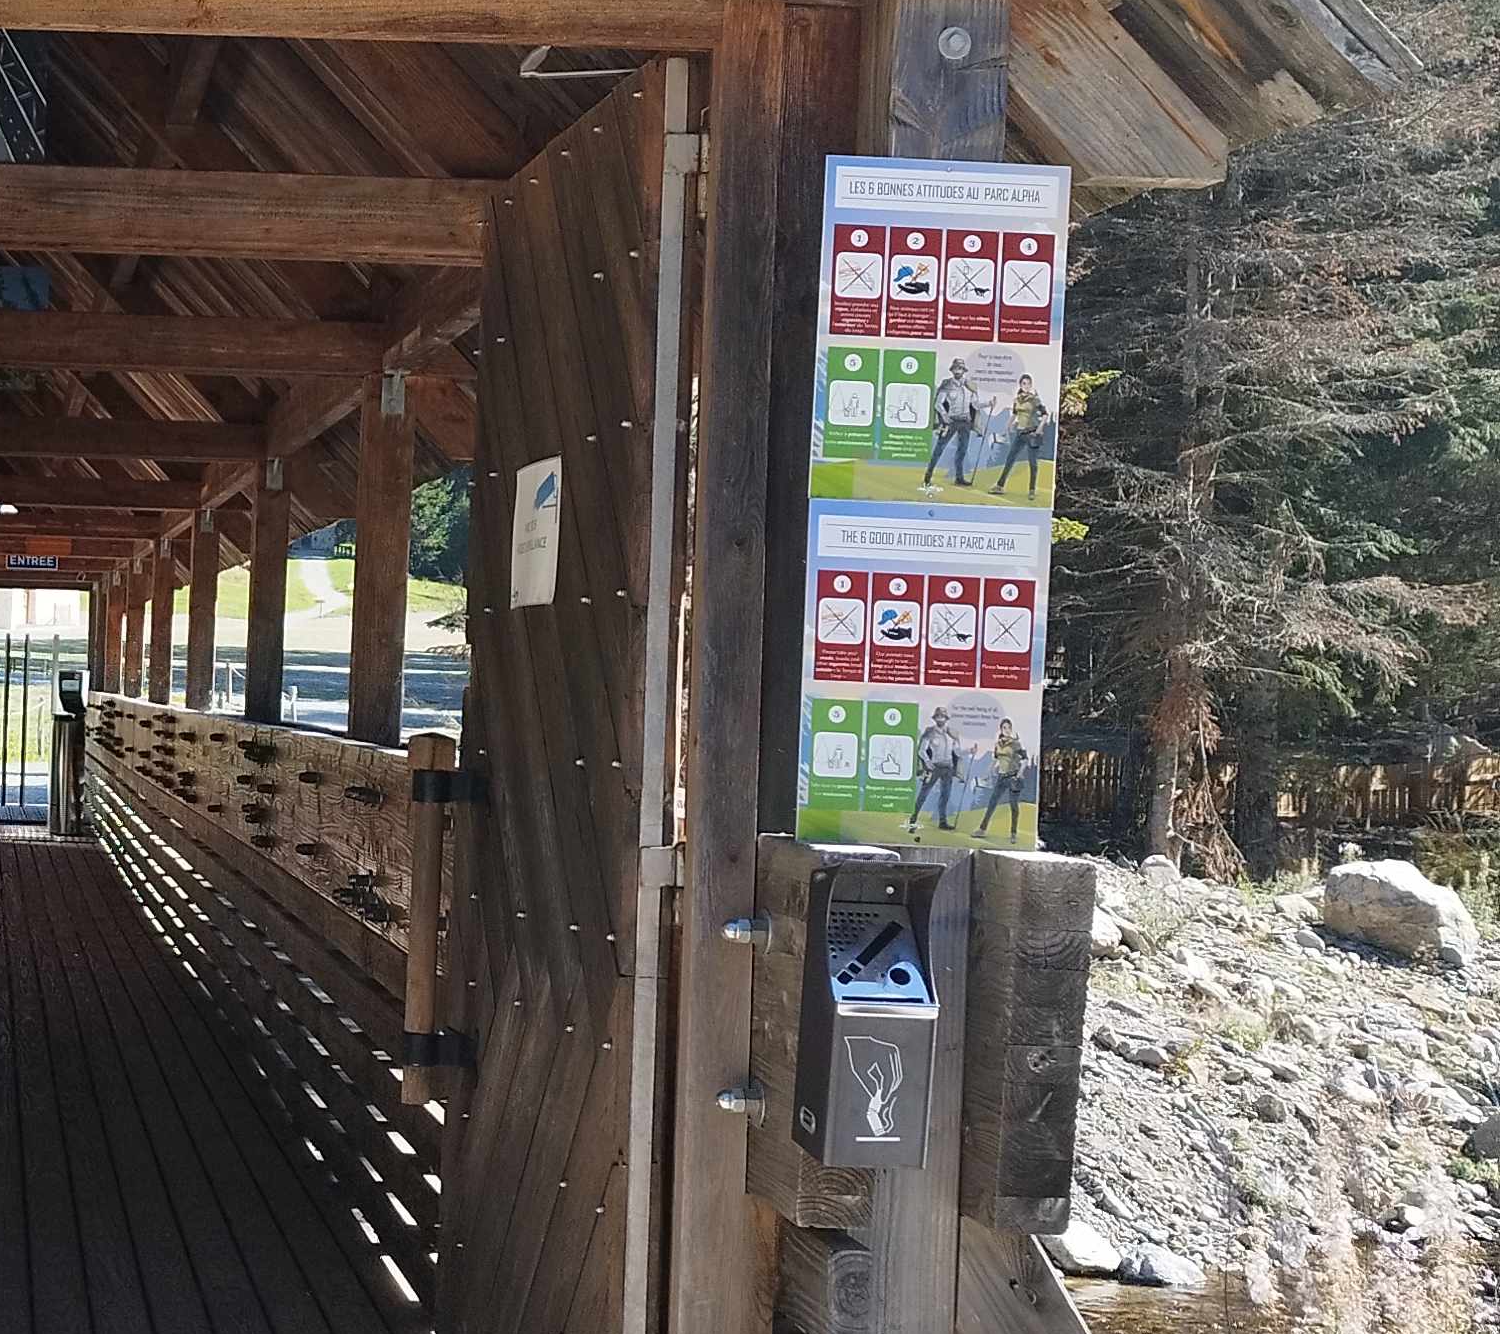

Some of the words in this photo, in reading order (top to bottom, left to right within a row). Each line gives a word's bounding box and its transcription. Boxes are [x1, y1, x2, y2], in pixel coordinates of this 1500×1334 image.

[849, 180, 866, 195] LES
[868, 181, 875, 195] 6
[877, 181, 914, 197] BONNES
[916, 184, 965, 200] ATTITUDES
[966, 186, 980, 200] AU
[984, 187, 1009, 202] PARC
[1011, 188, 1041, 204] ALPHA
[841, 529, 859, 544] THE
[860, 530, 867, 544] 6
[869, 531, 895, 545] GOOD
[897, 532, 944, 548] ATTITUDES
[946, 534, 958, 548] AT
[960, 535, 985, 550] PARC
[986, 536, 1016, 551] ALPHA
